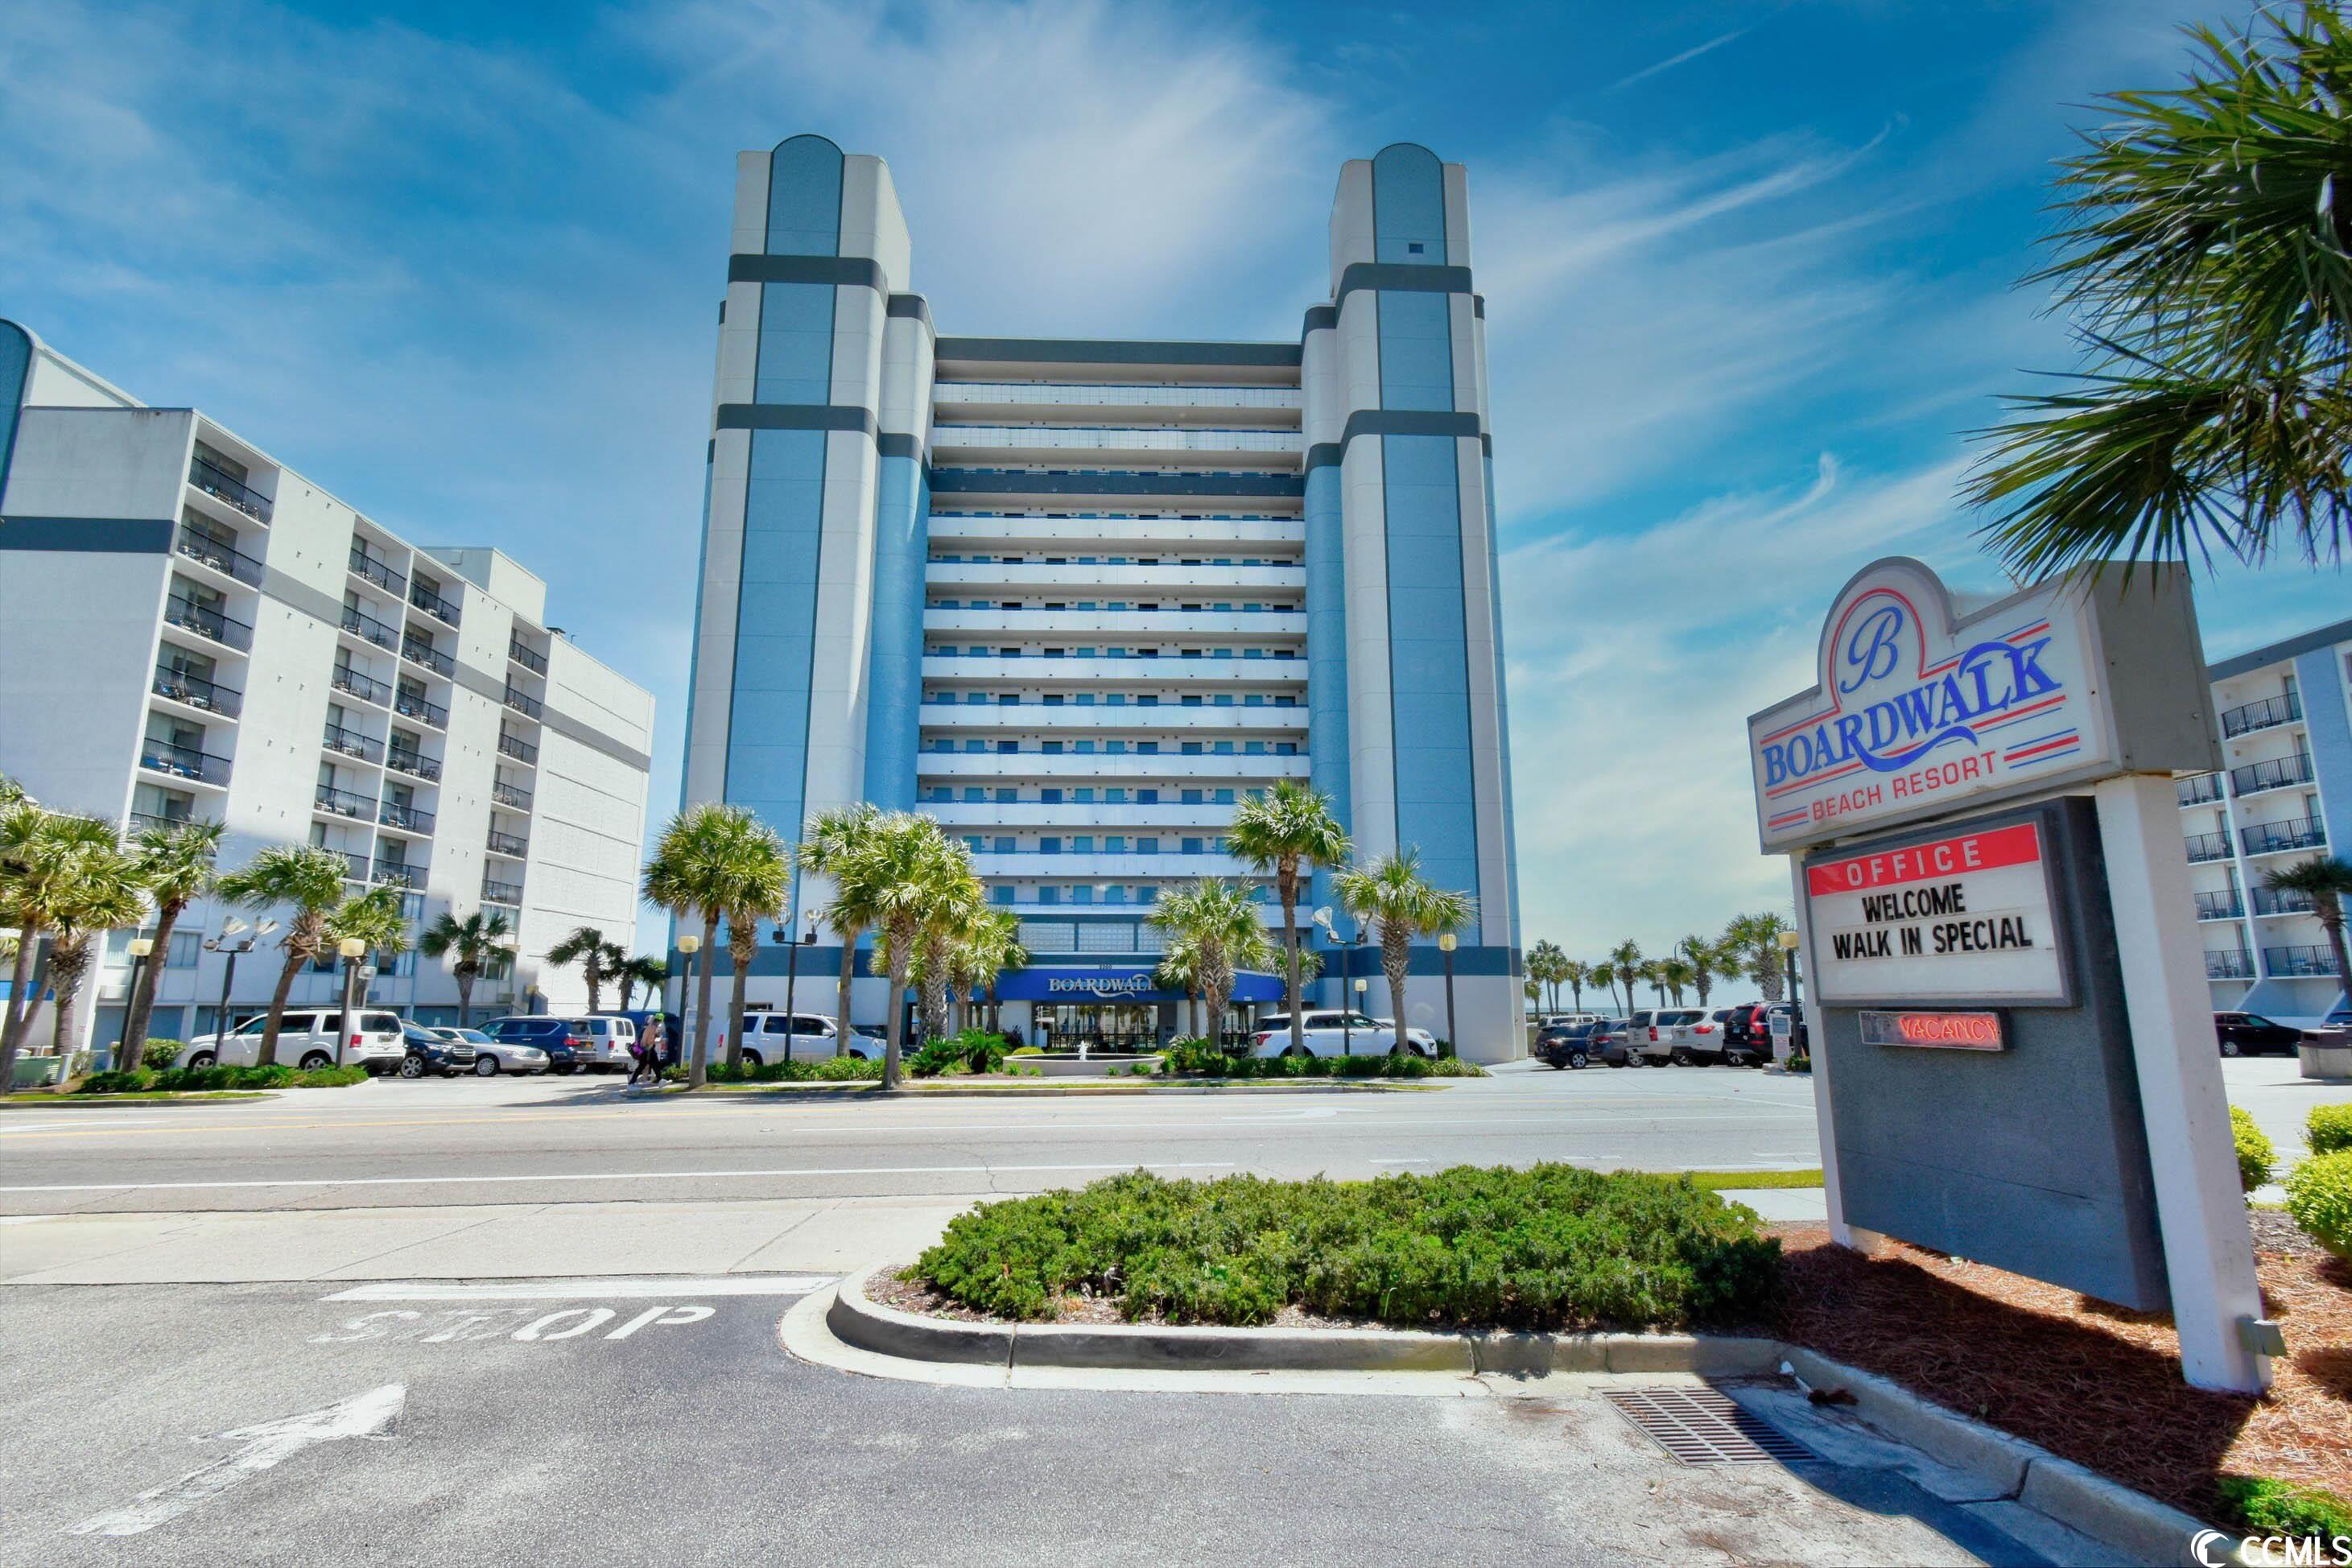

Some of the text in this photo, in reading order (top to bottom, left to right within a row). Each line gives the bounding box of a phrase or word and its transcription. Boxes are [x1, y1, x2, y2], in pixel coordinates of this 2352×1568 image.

[1840, 605, 1904, 694] B
[1761, 637, 2062, 787] BOARDWALK
[1812, 750, 1998, 821] BEACH RESORT
[1847, 839, 1983, 886] OFFICE
[1862, 883, 1966, 923] WELCOME
[1832, 916, 2033, 959] WALK IN SPECIAL
[1899, 1017, 1999, 1041] VACANCY
[306, 1305, 716, 1343] STOP
